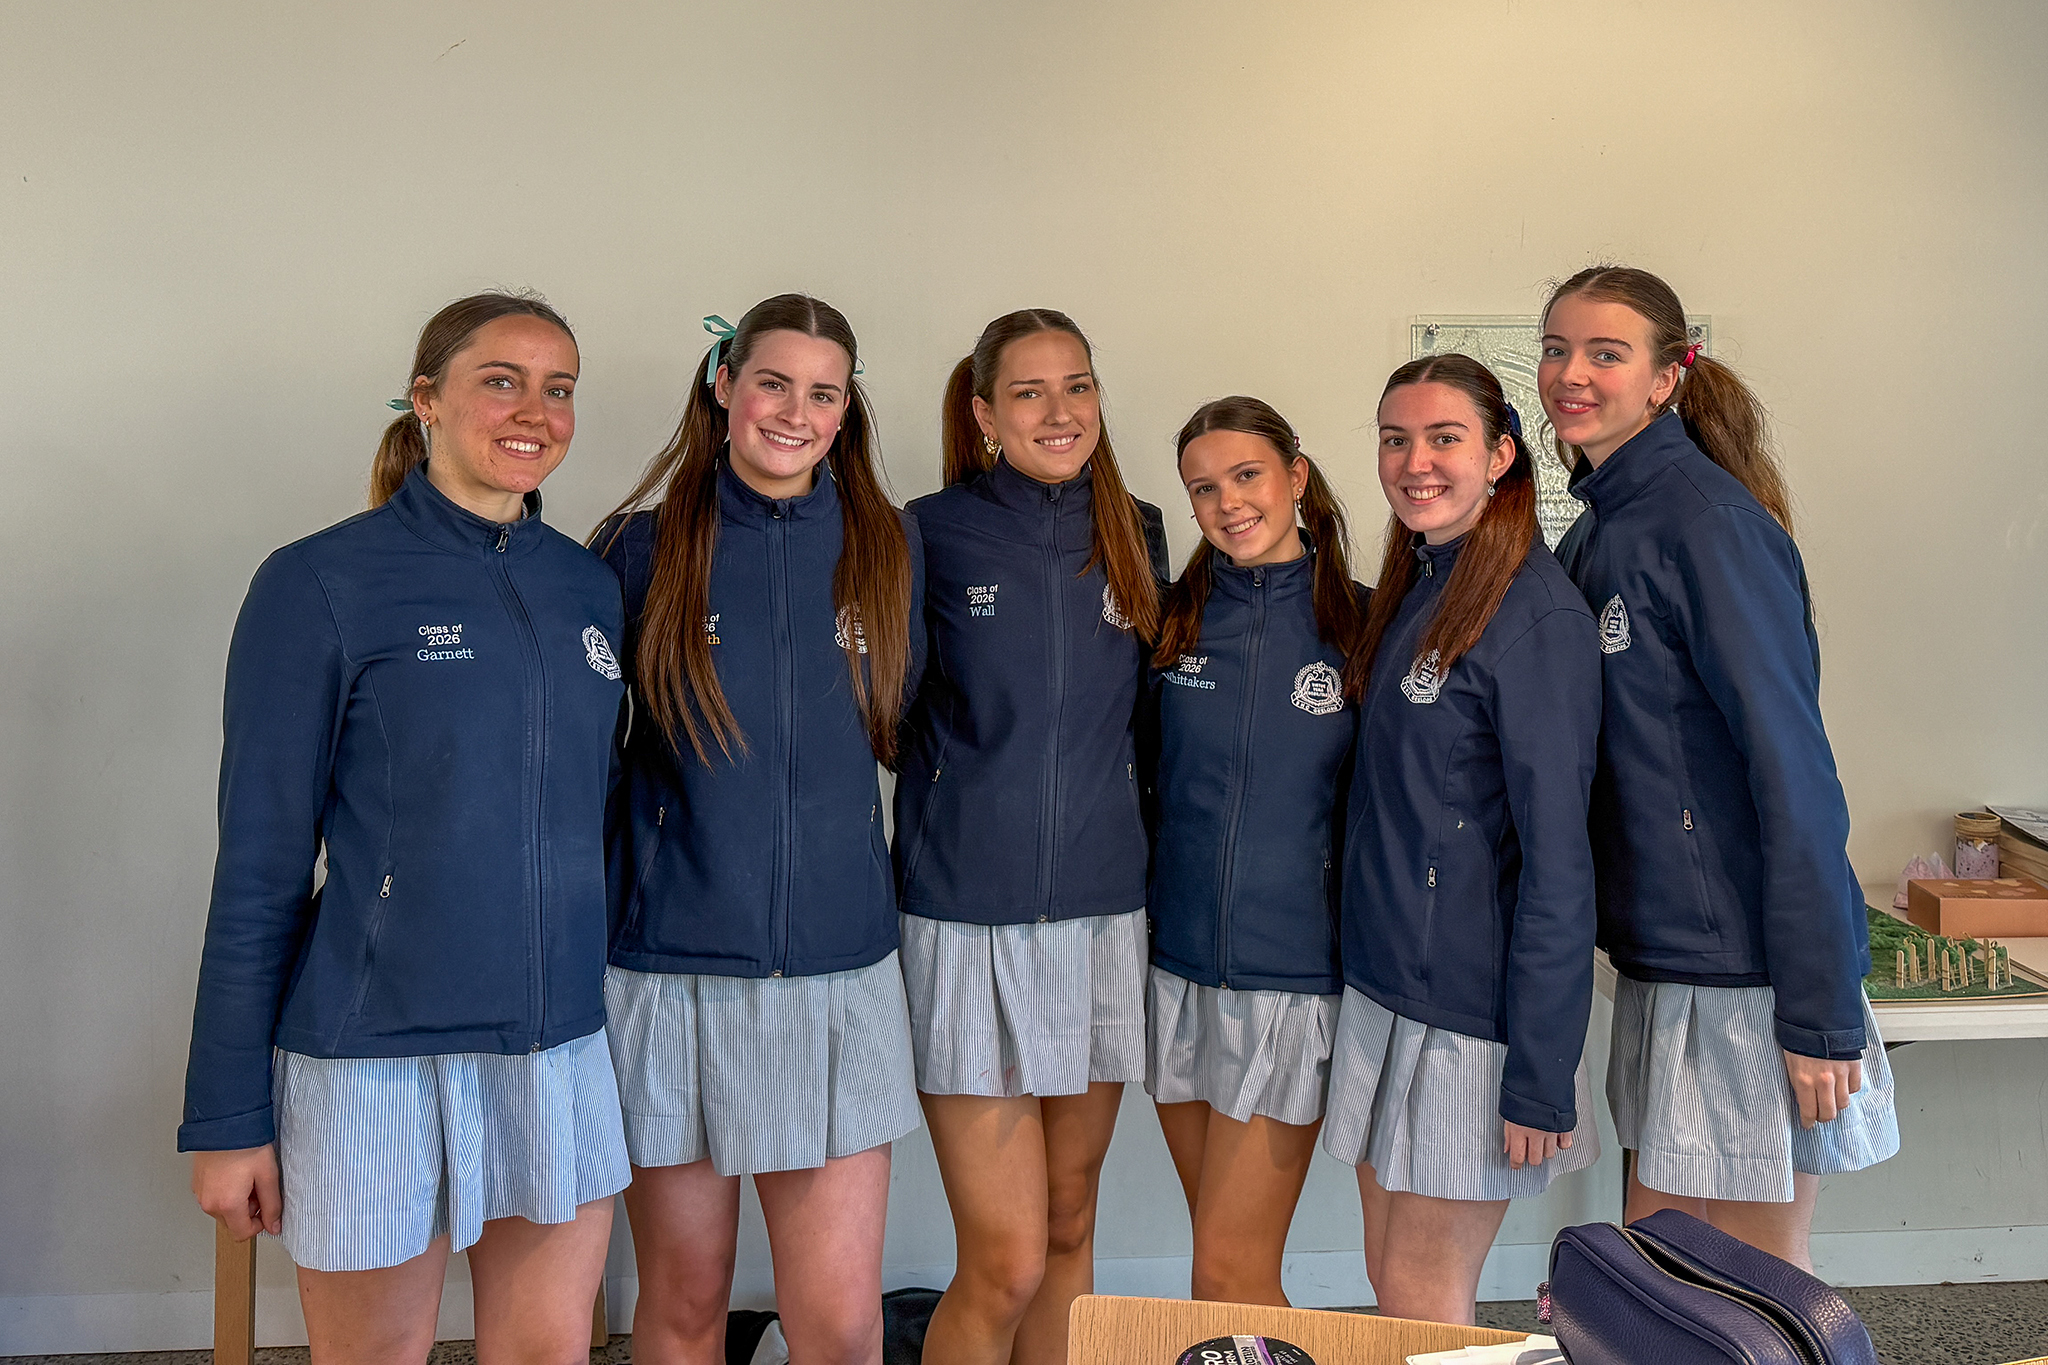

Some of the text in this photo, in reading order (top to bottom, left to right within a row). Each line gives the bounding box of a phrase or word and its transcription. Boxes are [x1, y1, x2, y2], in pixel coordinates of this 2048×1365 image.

[966, 584, 999, 596] Class of
[970, 593, 995, 605] 2026
[969, 604, 996, 617] Wall
[709, 613, 720, 622] of
[418, 623, 463, 636] Class of
[427, 633, 461, 646] 2026
[416, 647, 475, 661] Garnett
[1178, 653, 1208, 665] Class of
[1178, 663, 1202, 673] 2026
